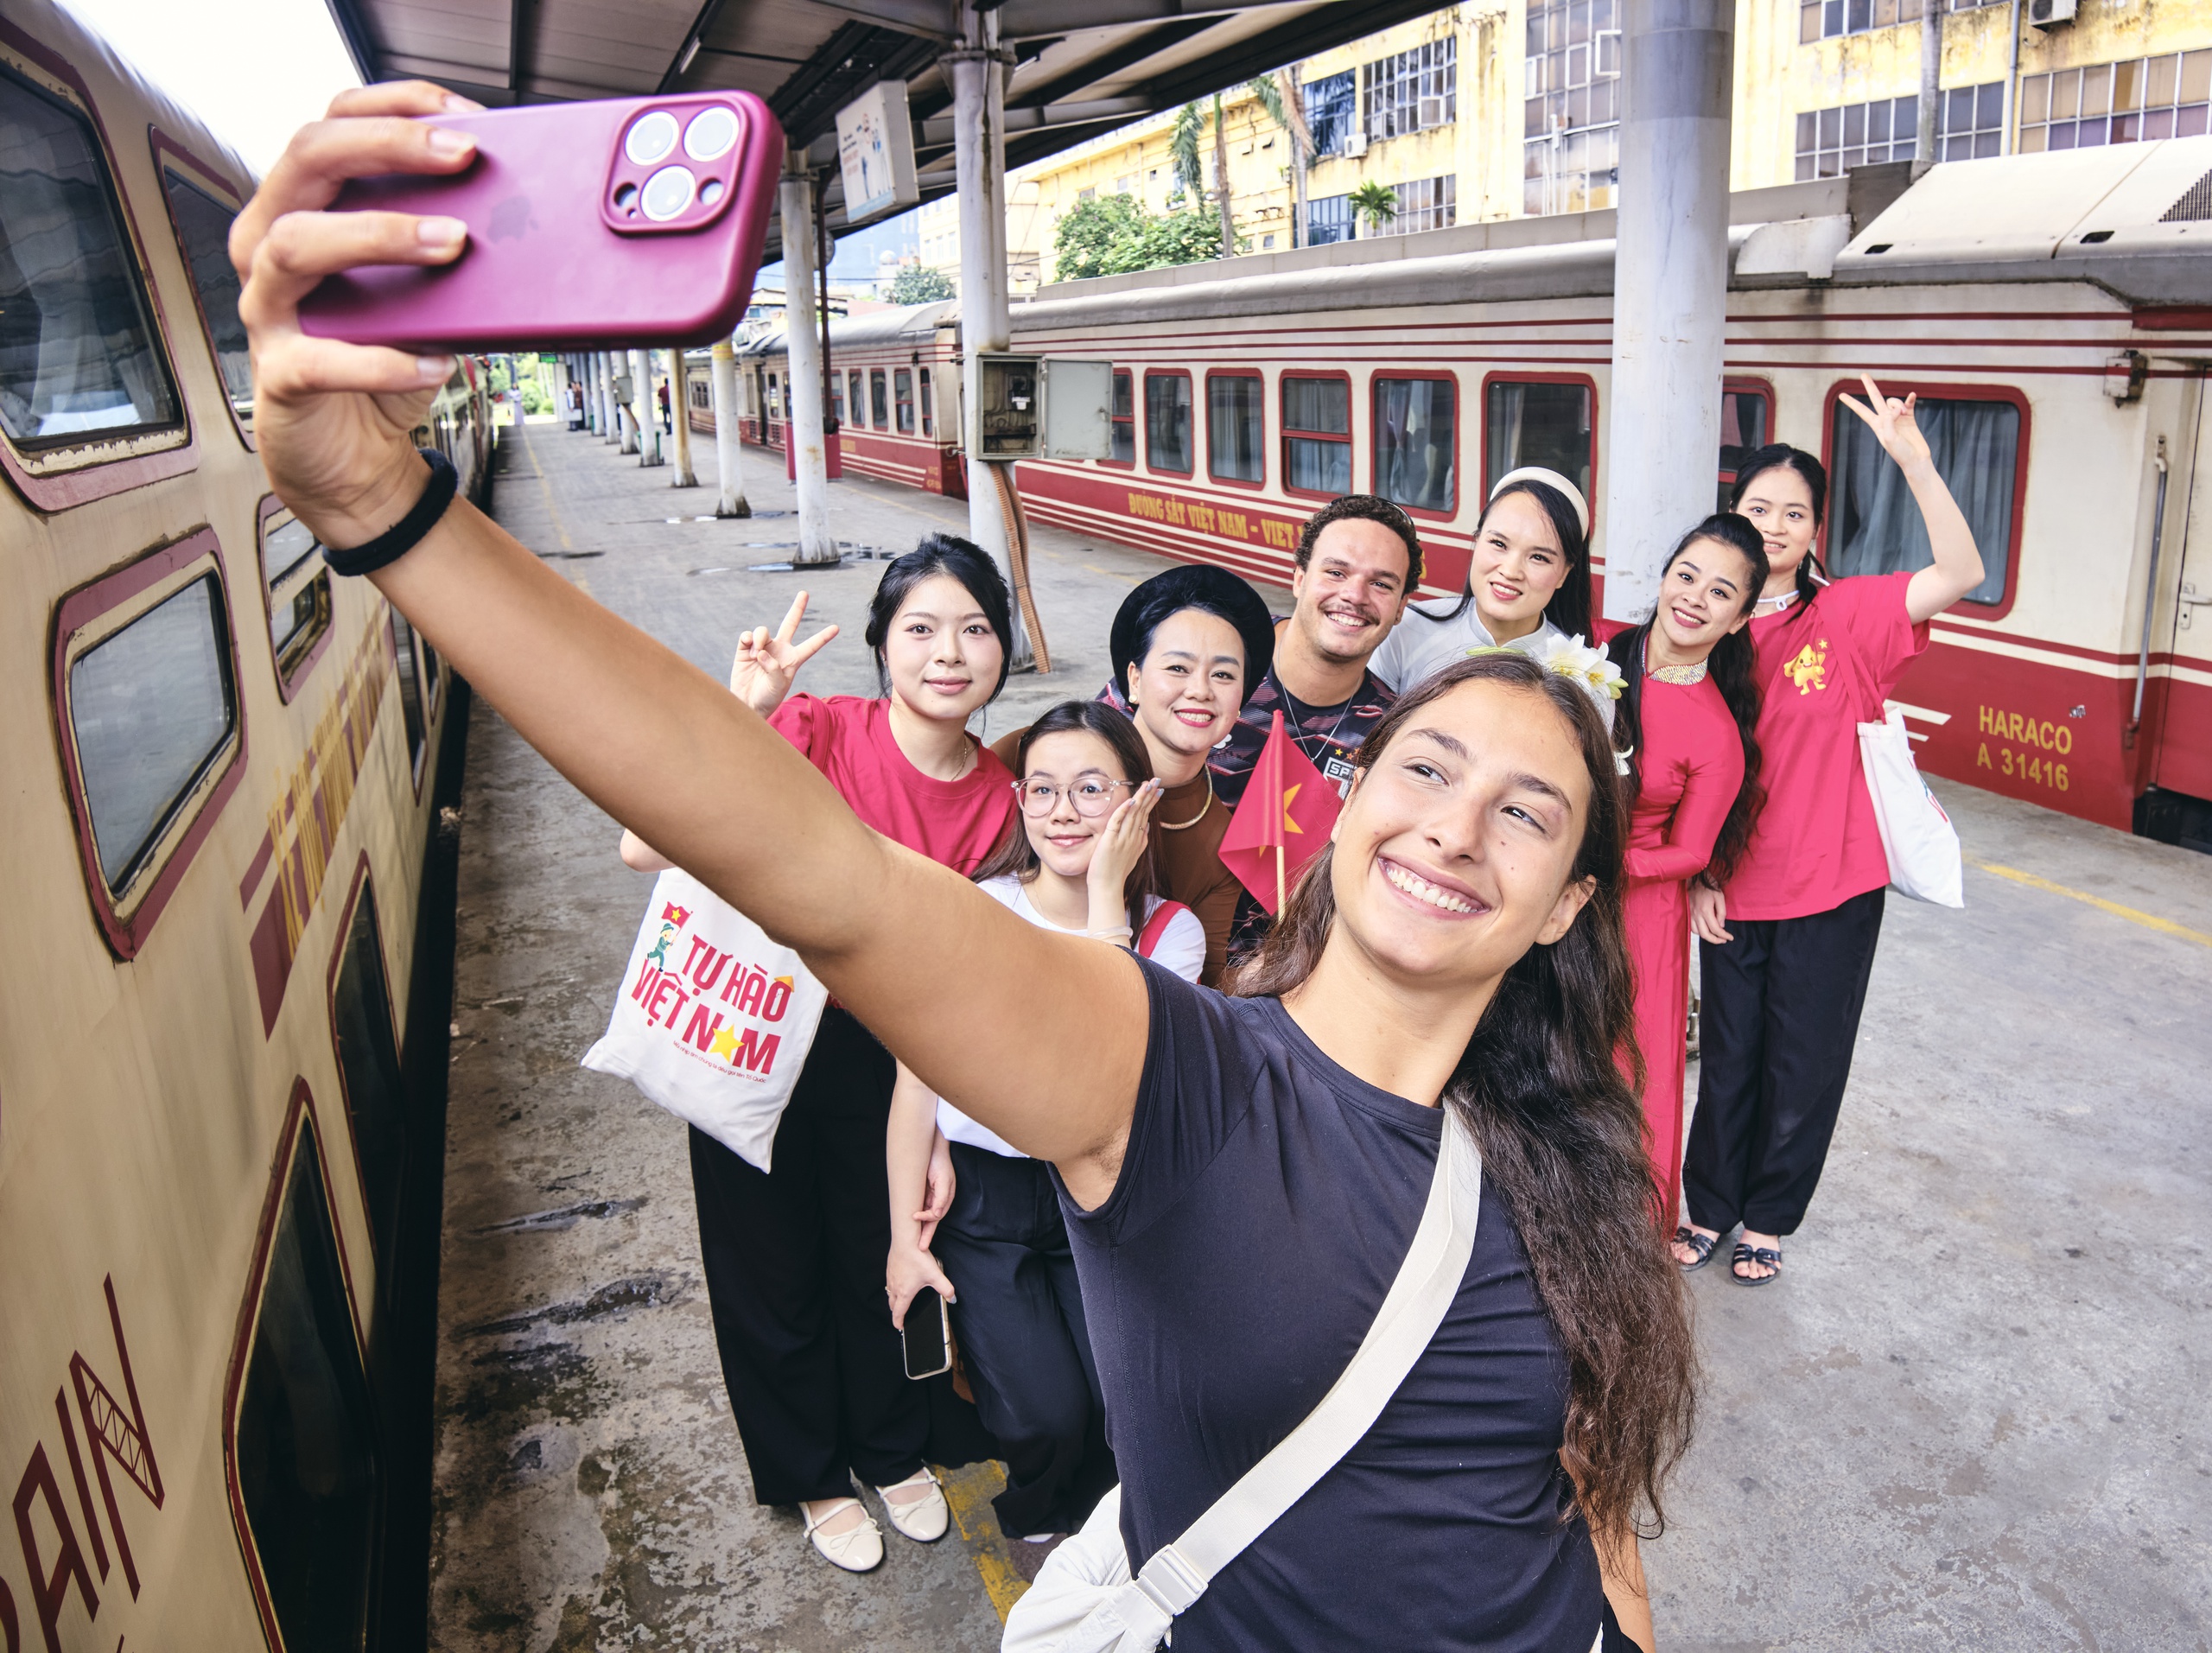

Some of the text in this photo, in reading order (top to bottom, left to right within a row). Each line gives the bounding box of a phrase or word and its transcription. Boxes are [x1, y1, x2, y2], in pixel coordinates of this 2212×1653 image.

[1187, 501, 1215, 534] VIỆT
[1217, 510, 1249, 539] NAM
[1261, 518, 1294, 549] VIET
[1980, 704, 2072, 754] HARACO
[1976, 742, 2069, 792] A 31416
[631, 958, 690, 1031] VIỆT
[681, 933, 793, 1022] TỰ HÀO
[0, 1272, 165, 1653] AIN
